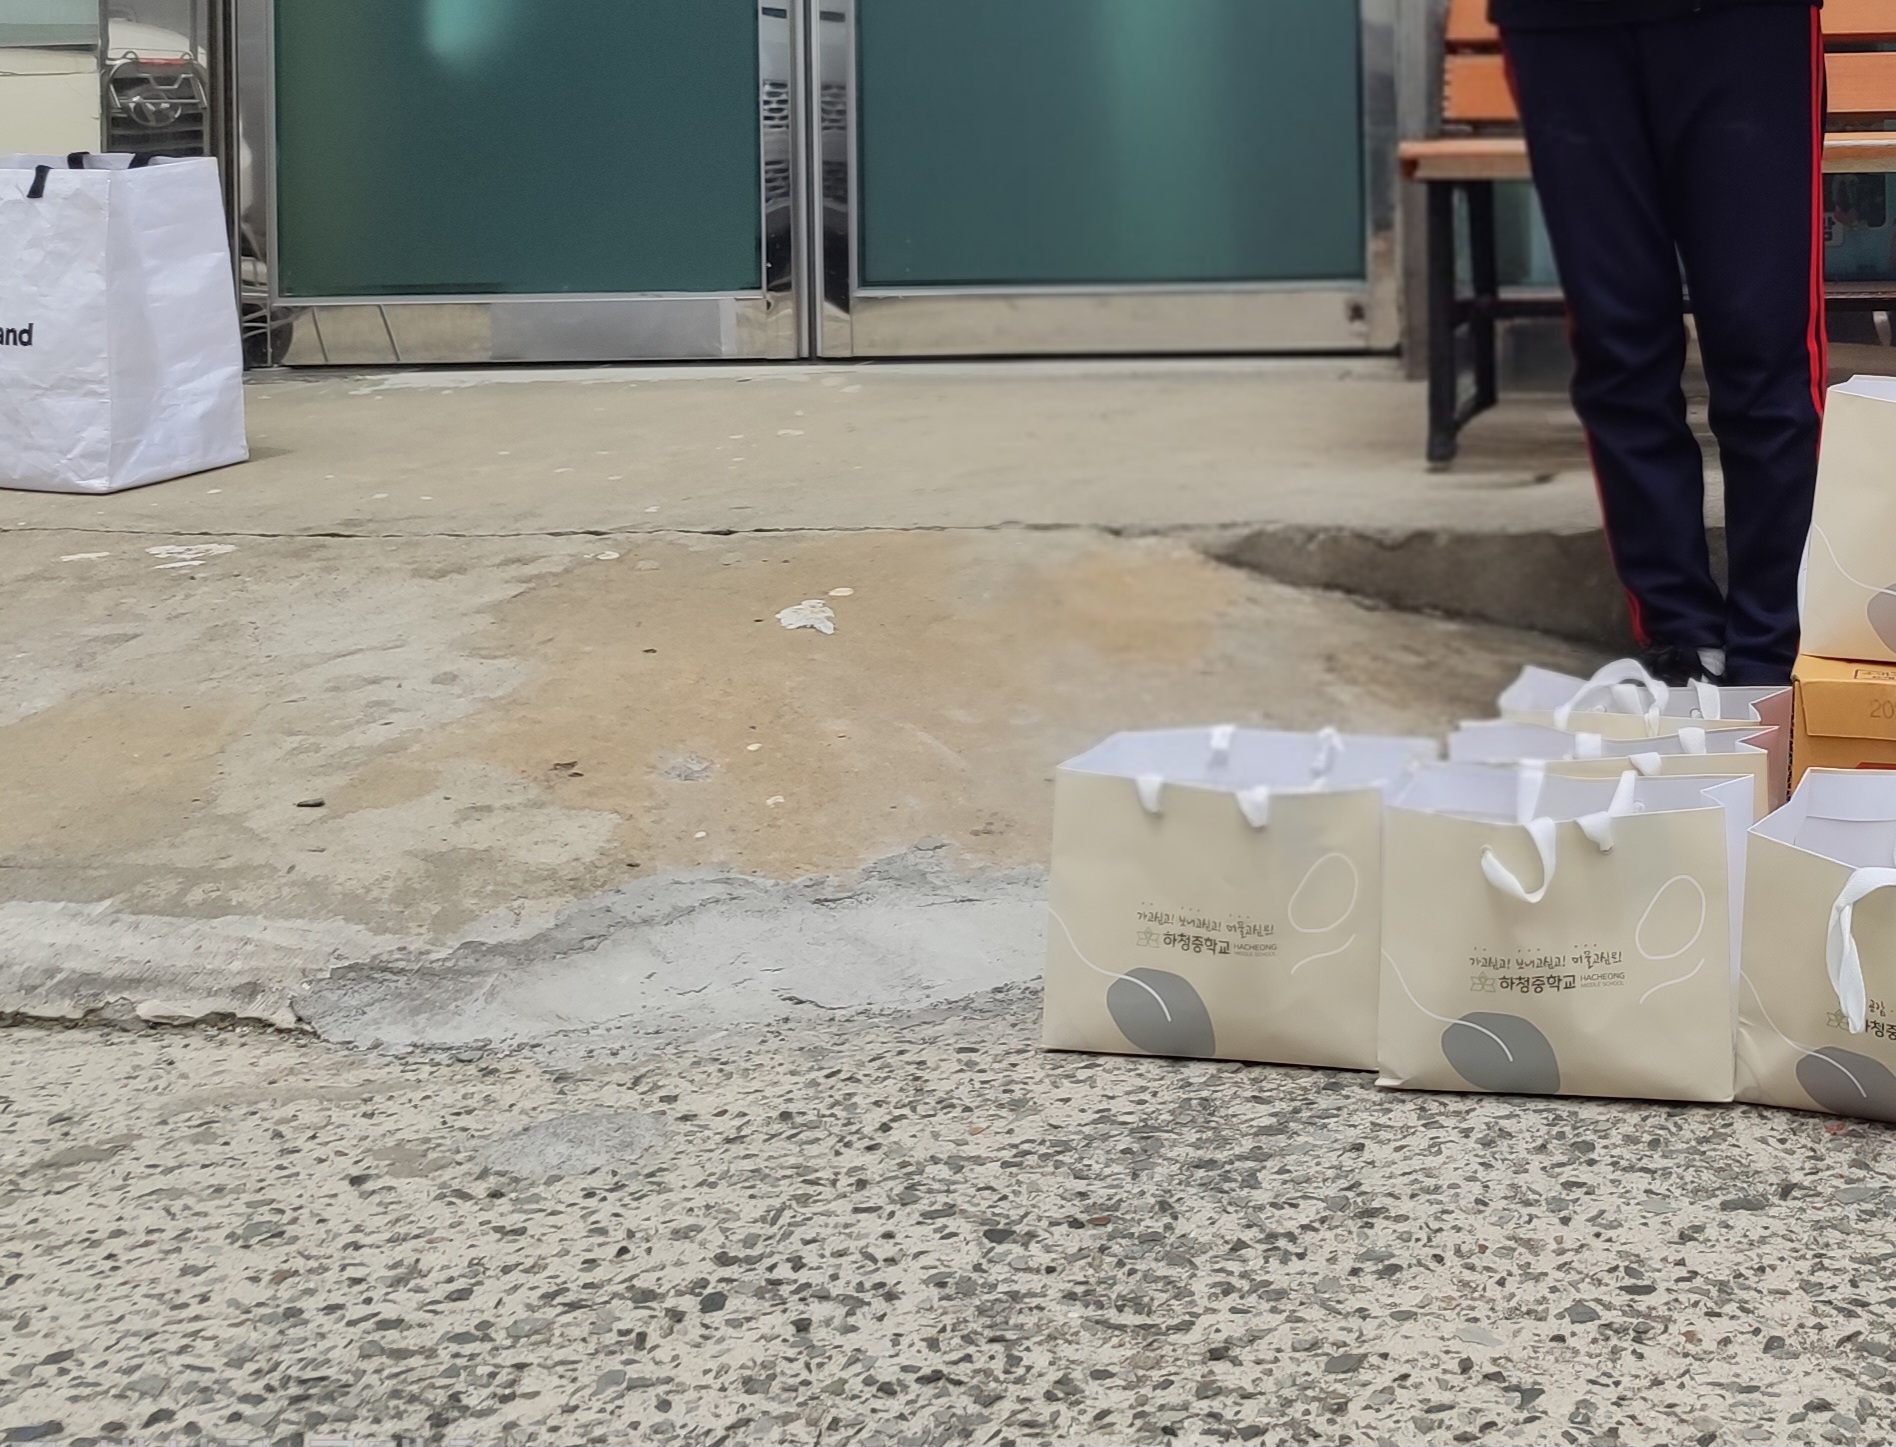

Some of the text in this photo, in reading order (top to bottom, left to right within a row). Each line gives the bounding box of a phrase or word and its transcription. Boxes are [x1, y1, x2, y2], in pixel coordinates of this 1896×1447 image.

[1163, 931, 1277, 955] 하청중학교 HACHEONG
[1499, 972, 1625, 993] 하청중학교 HACHEONG
